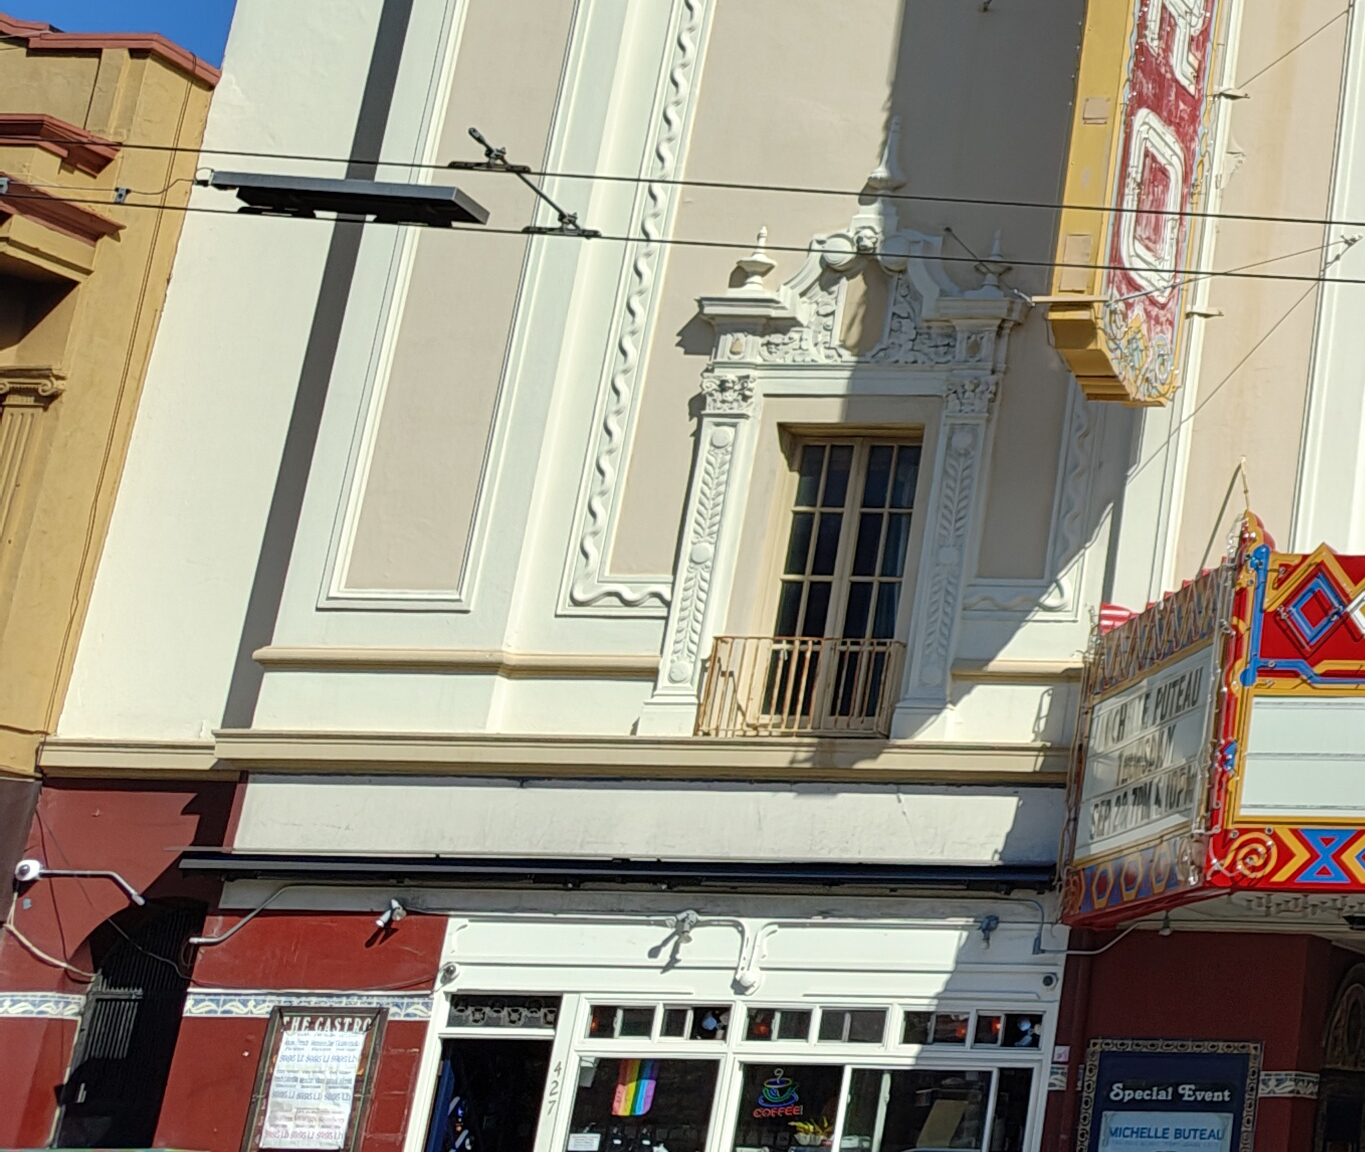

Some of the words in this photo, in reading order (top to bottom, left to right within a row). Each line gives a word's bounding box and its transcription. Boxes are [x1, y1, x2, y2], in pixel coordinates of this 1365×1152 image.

[1109, 1083, 1173, 1103] Special
[1177, 1084, 1231, 1102] Event
[752, 1105, 801, 1118] COFFEE
[1109, 1126, 1169, 1140] MICHELLE
[1174, 1128, 1222, 1140] BUTEAU
